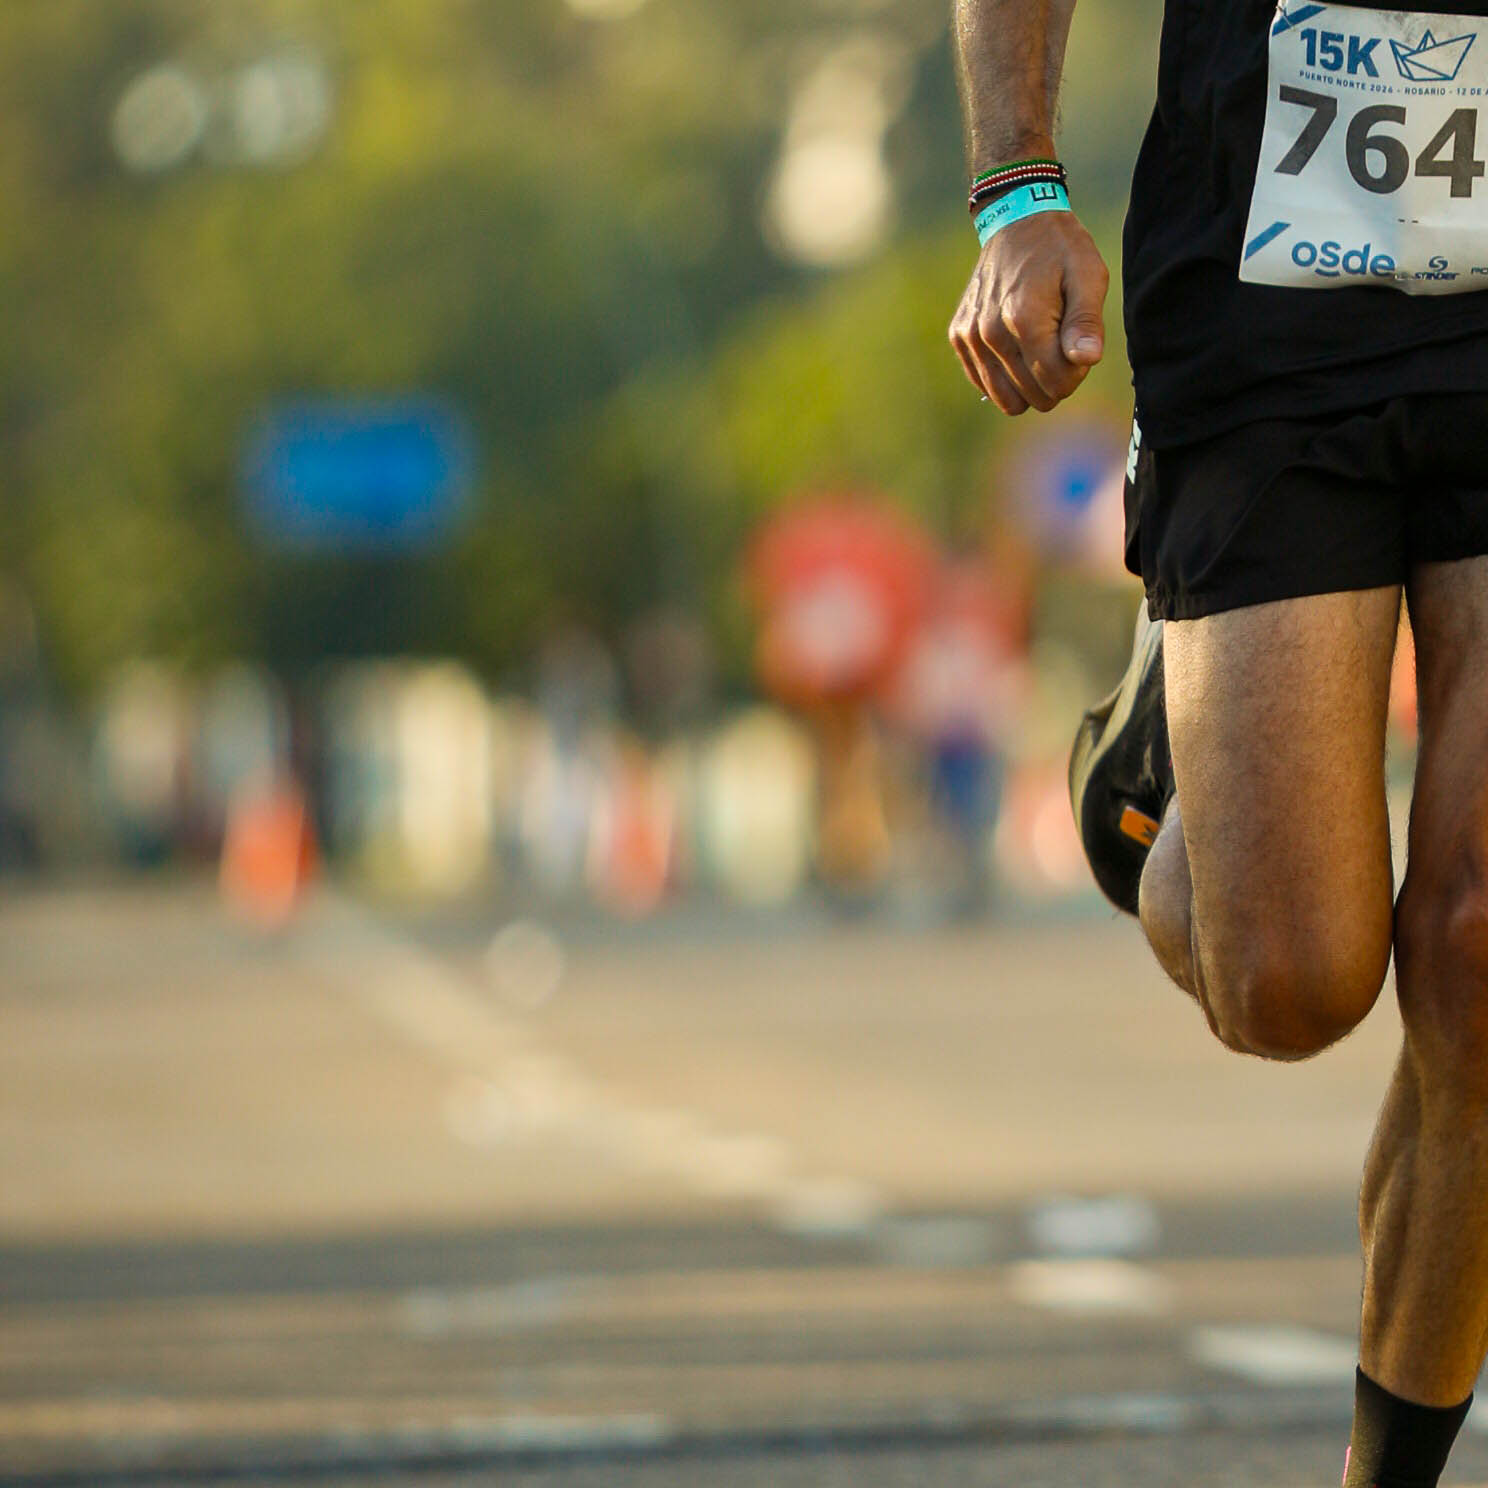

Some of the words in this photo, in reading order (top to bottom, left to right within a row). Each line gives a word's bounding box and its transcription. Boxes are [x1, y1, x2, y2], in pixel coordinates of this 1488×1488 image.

[1299, 28, 1382, 78] 15K
[1299, 69, 1334, 85] PUERTO
[1335, 78, 1367, 91] NORTE
[1404, 86, 1446, 96] ROSARIO
[1470, 87, 1482, 97] DE
[1291, 240, 1396, 277] osde
